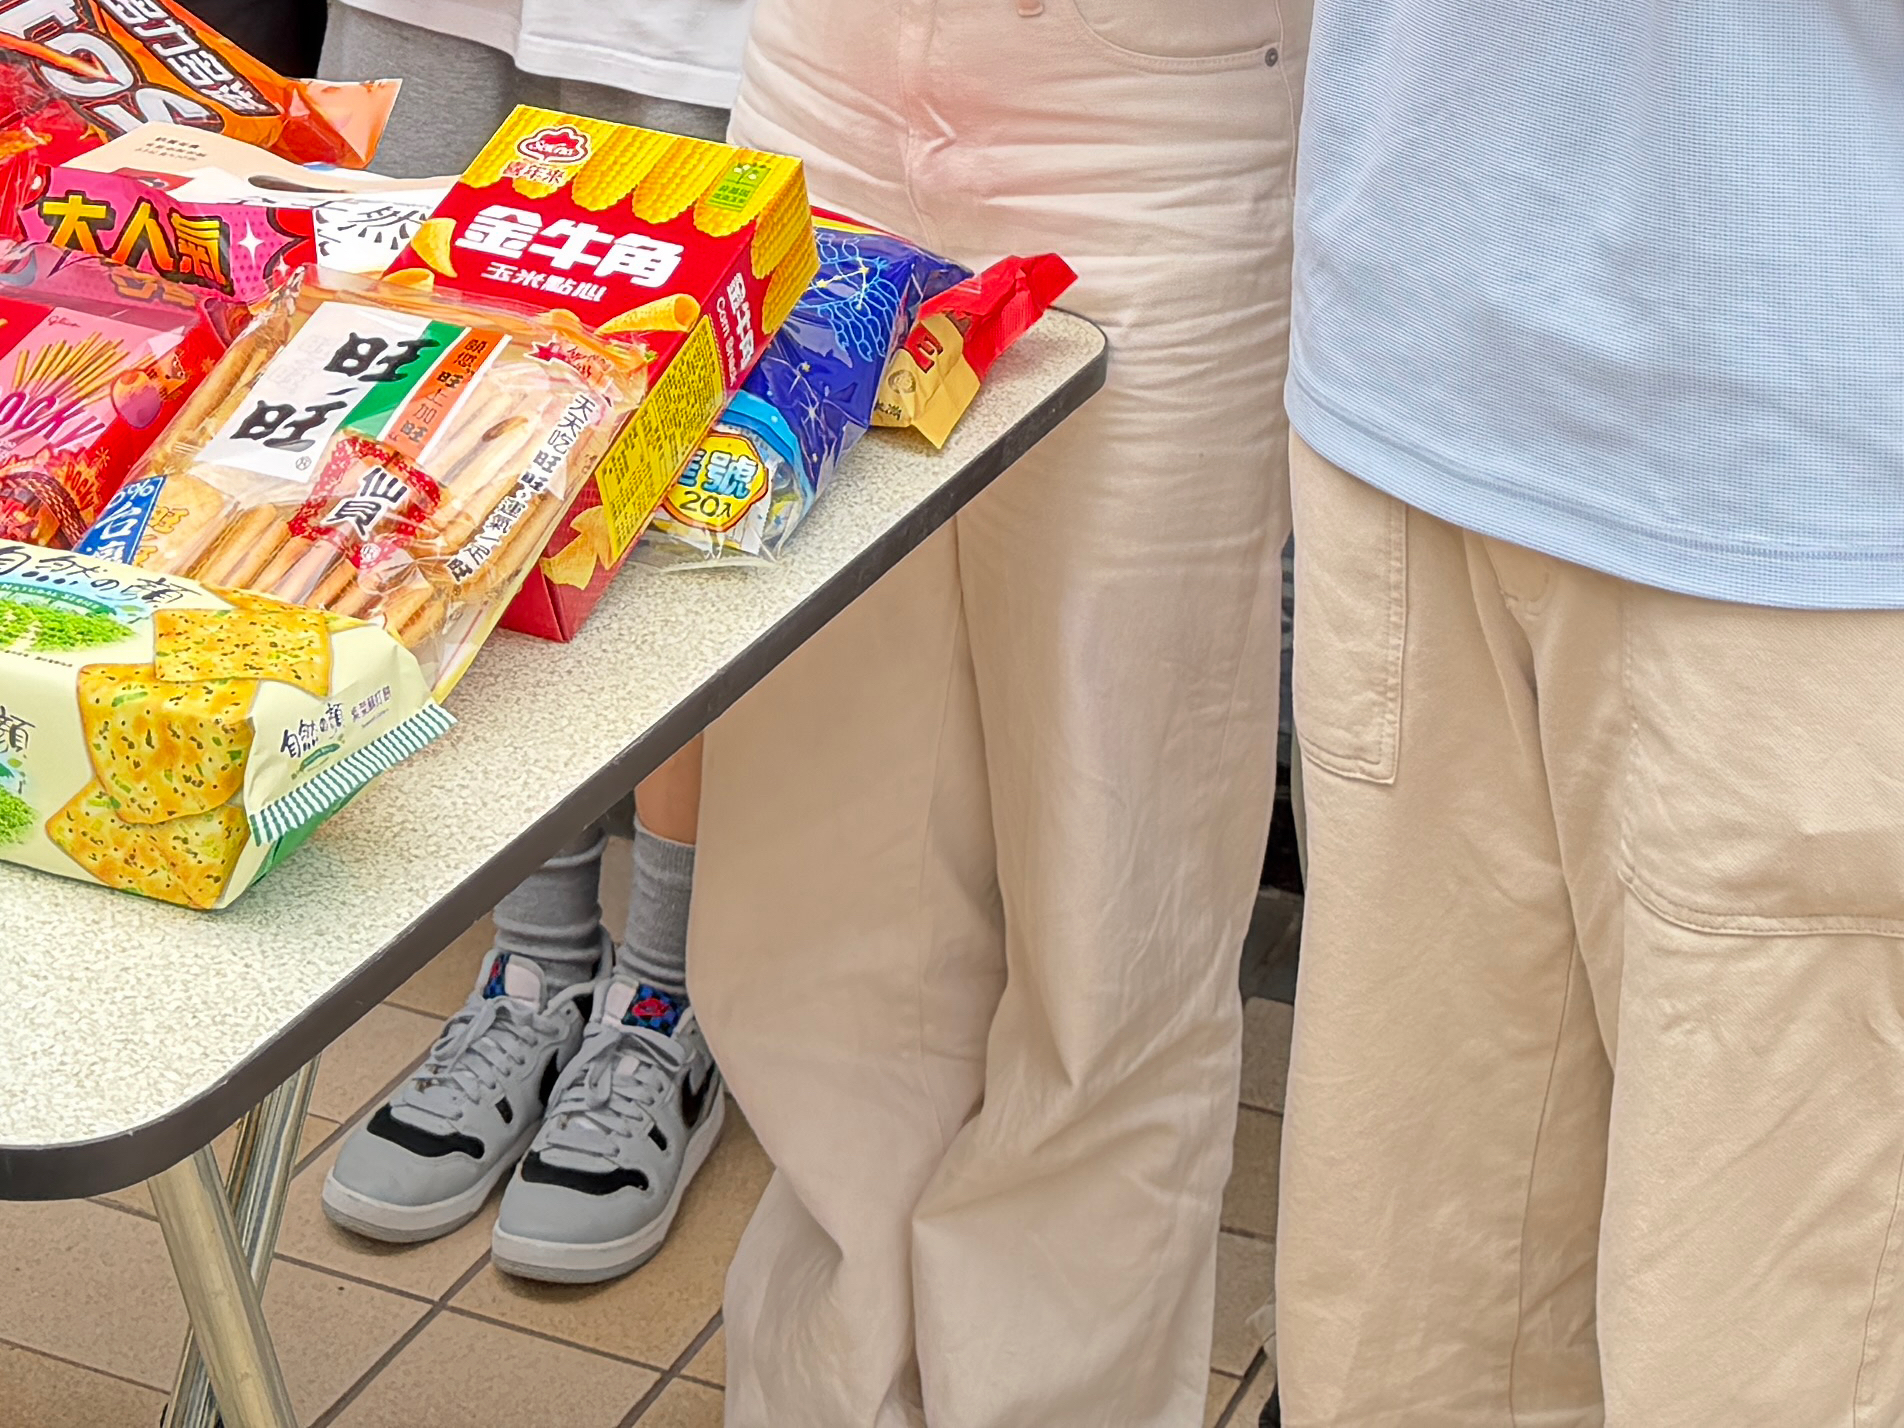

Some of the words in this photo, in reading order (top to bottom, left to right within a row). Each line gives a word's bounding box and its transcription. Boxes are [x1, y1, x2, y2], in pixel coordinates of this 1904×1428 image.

[41, 190, 234, 296] 大人氣
[454, 204, 685, 288] 金牛角
[480, 261, 608, 303] 玉米點心
[228, 330, 442, 453] 旺旺
[322, 465, 408, 541] 仙貝
